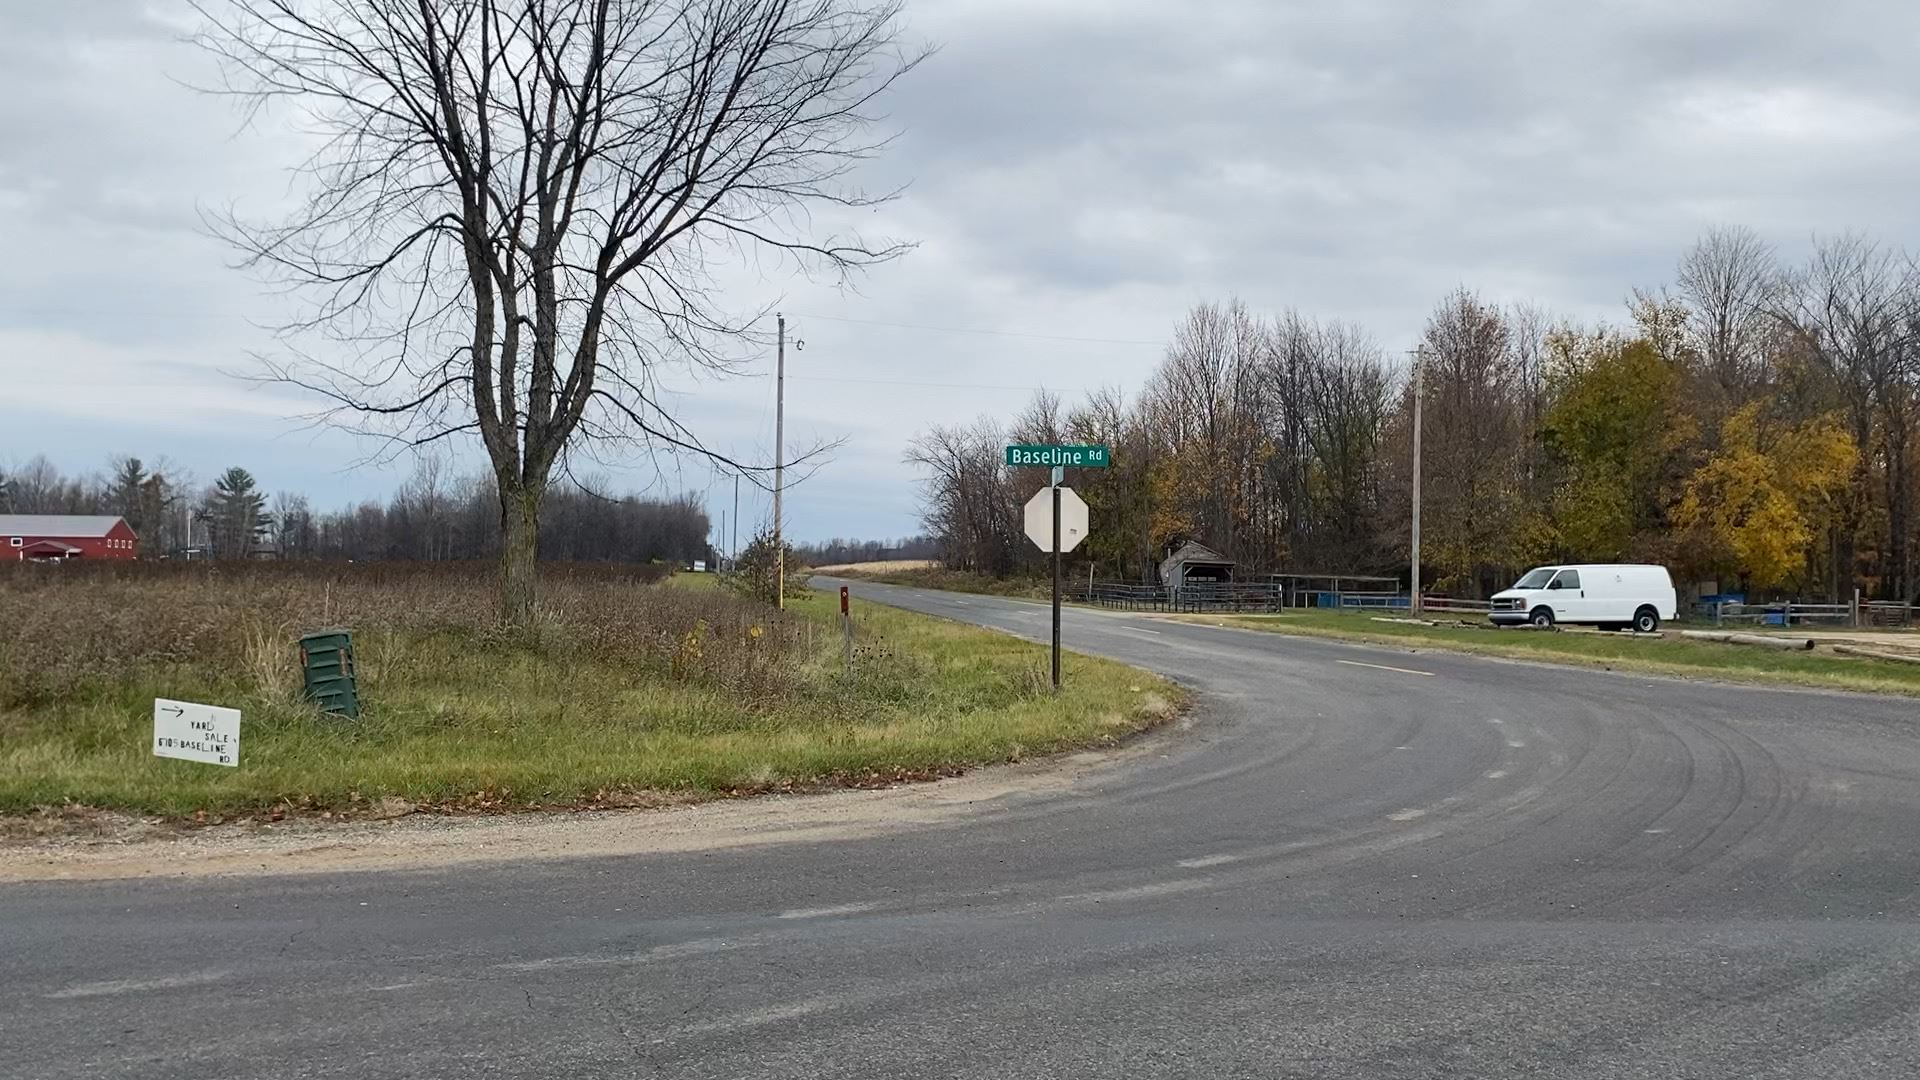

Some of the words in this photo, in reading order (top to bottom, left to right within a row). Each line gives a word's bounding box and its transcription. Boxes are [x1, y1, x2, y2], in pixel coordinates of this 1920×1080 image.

[1012, 448, 1082, 465] Baseline
[1089, 449, 1102, 461] Rd
[191, 721, 215, 731] YARD
[205, 733, 229, 743] SALE
[180, 740, 226, 754] BASELINE
[219, 755, 230, 763] RD
